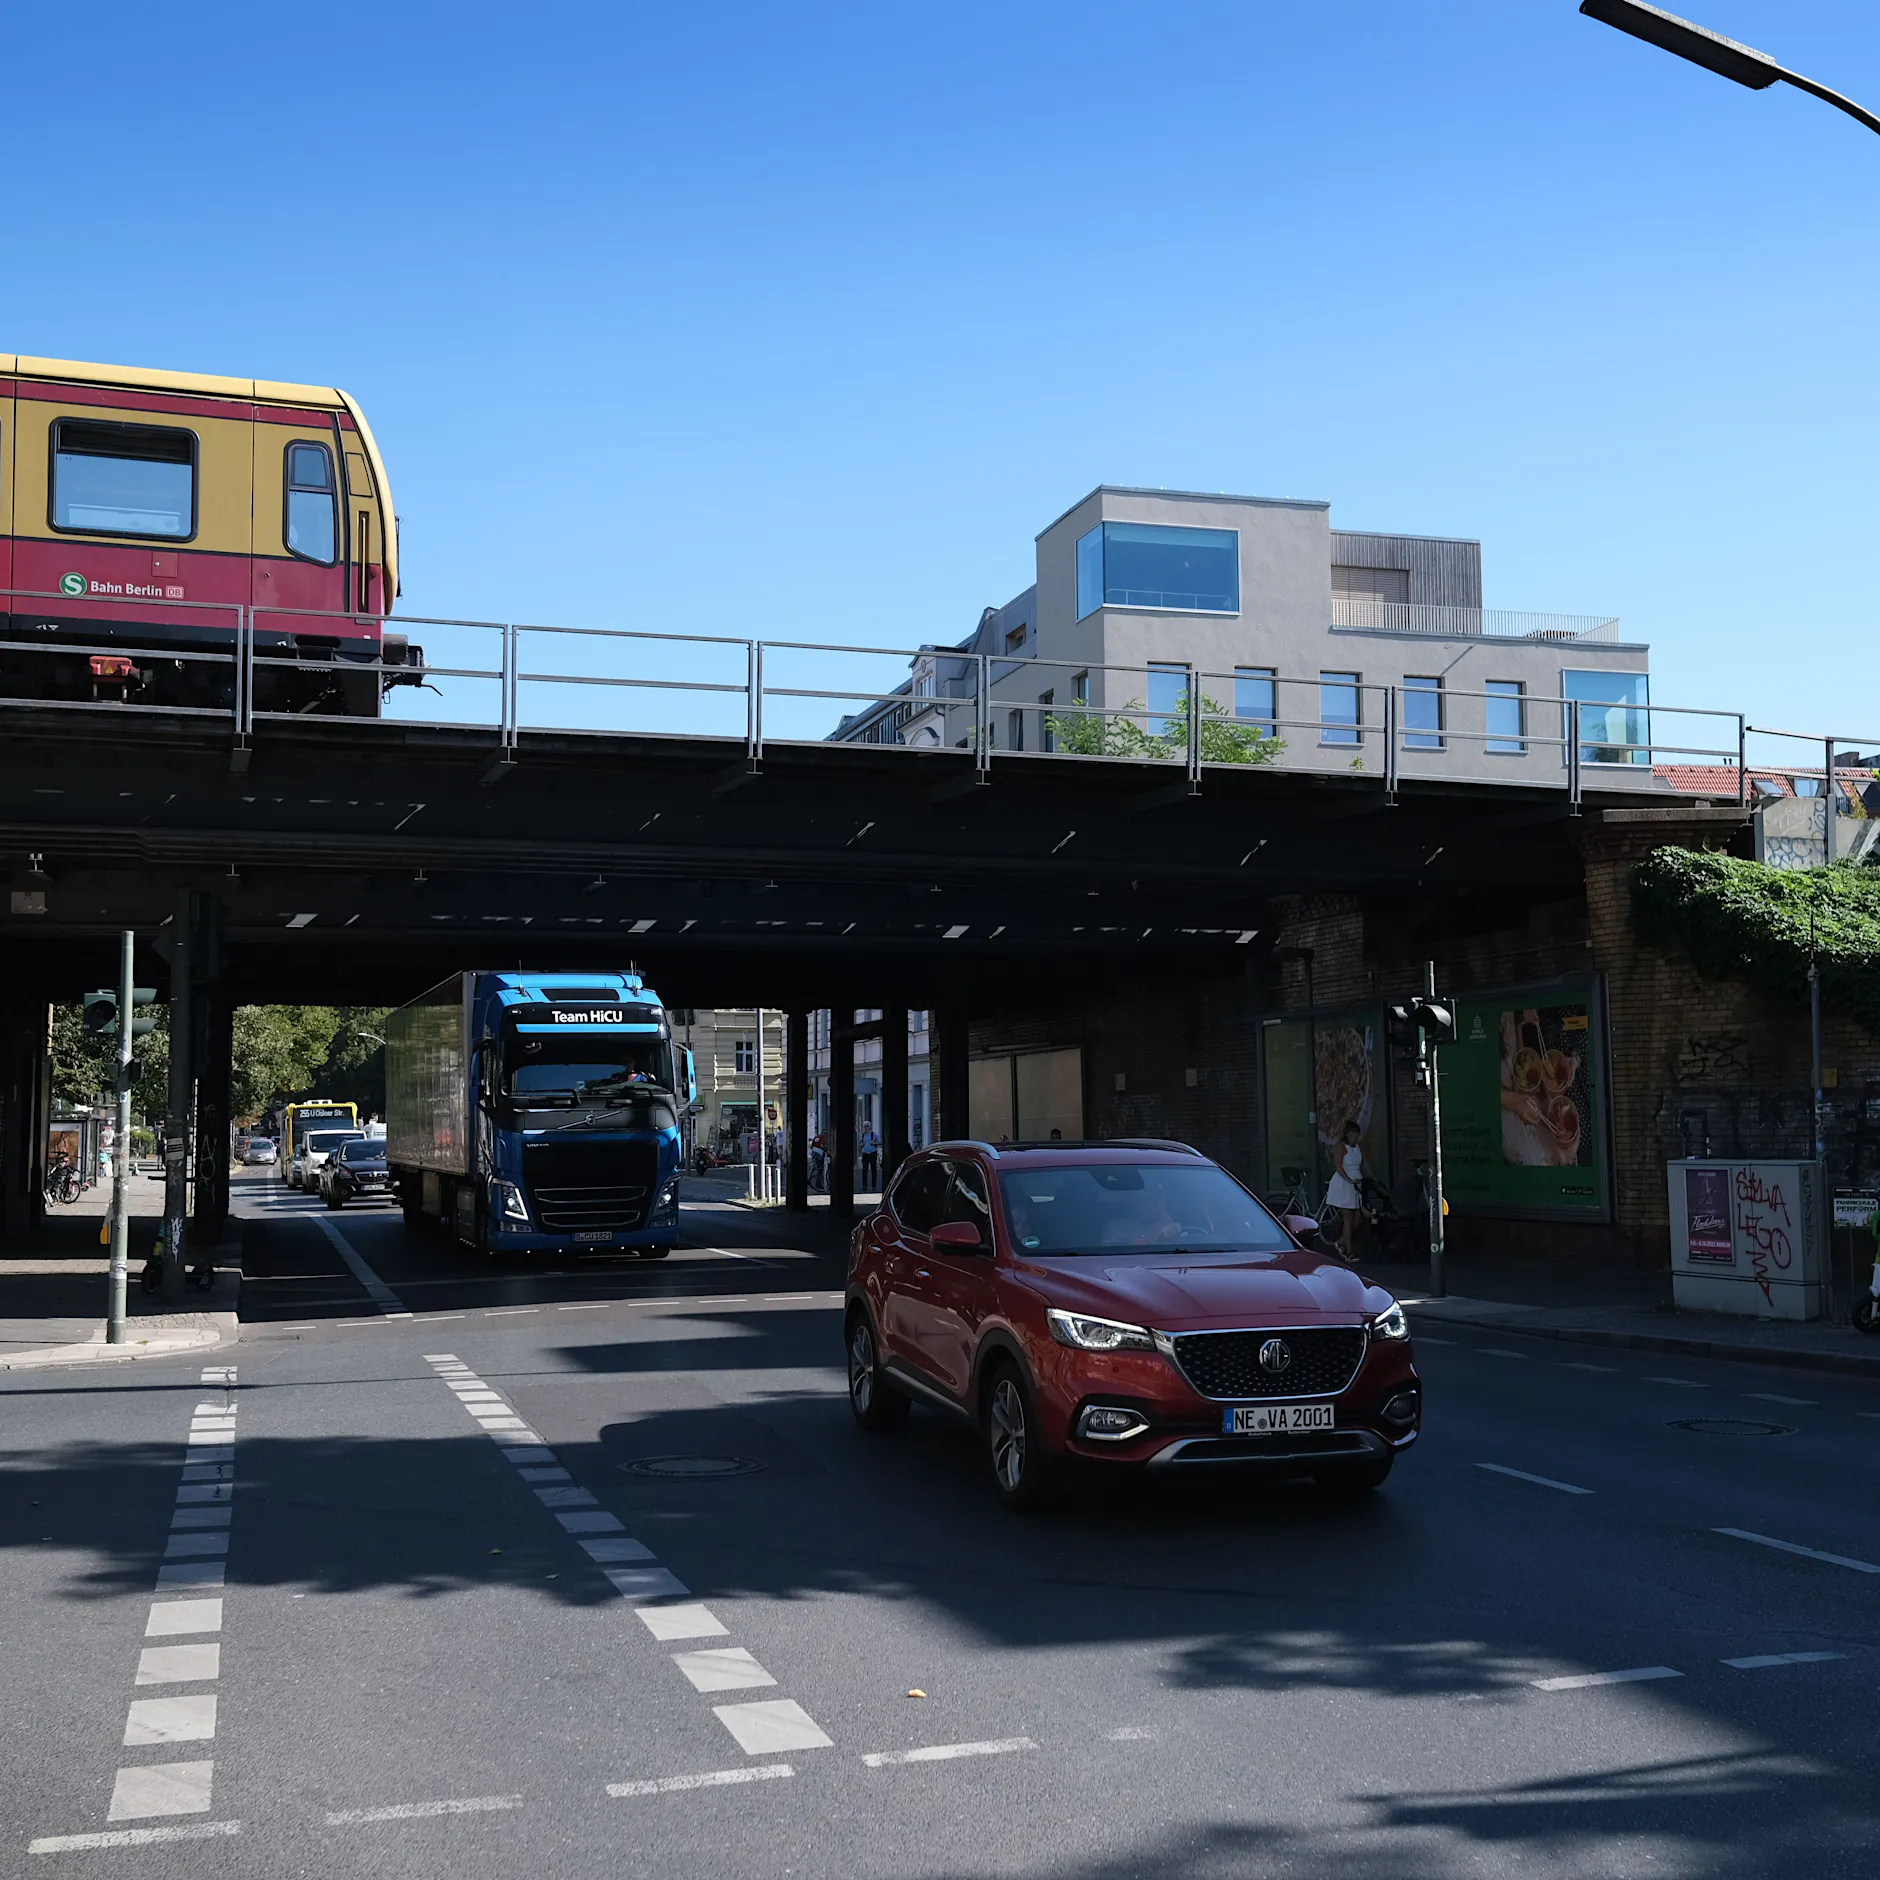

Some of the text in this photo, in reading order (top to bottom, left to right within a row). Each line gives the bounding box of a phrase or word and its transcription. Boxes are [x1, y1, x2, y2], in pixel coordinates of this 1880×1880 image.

[64, 575, 182, 598] S Bahn Berlin DB
[552, 1010, 622, 1022] Team HiCU
[300, 1109, 310, 1118] 255
[334, 1109, 345, 1117] Str.
[1262, 1340, 1290, 1371] MG
[1235, 1408, 1332, 1429] NE VA 2001
